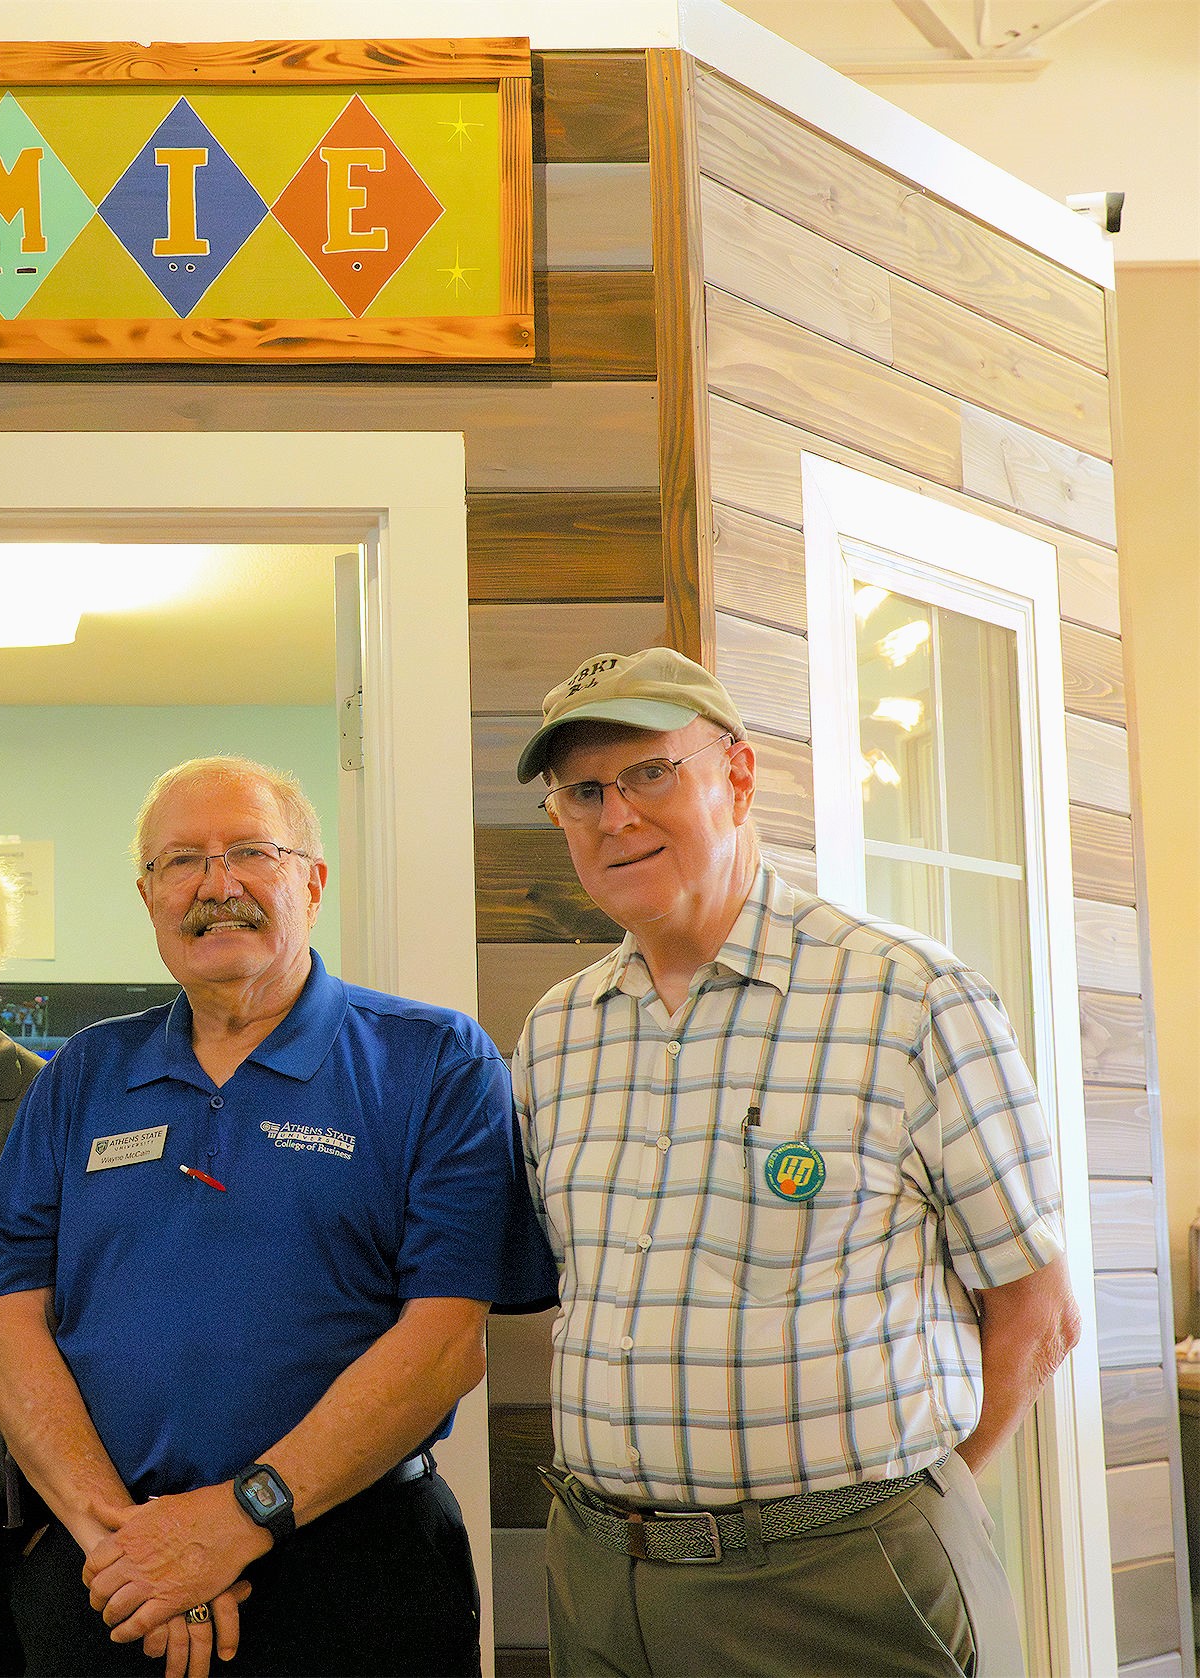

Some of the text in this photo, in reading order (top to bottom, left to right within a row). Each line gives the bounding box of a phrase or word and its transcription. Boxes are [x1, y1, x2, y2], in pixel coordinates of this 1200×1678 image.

[109, 1130, 163, 1147] ATHENS STATE
[325, 1127, 356, 1145] STATE
[274, 1139, 353, 1160] College of Business
